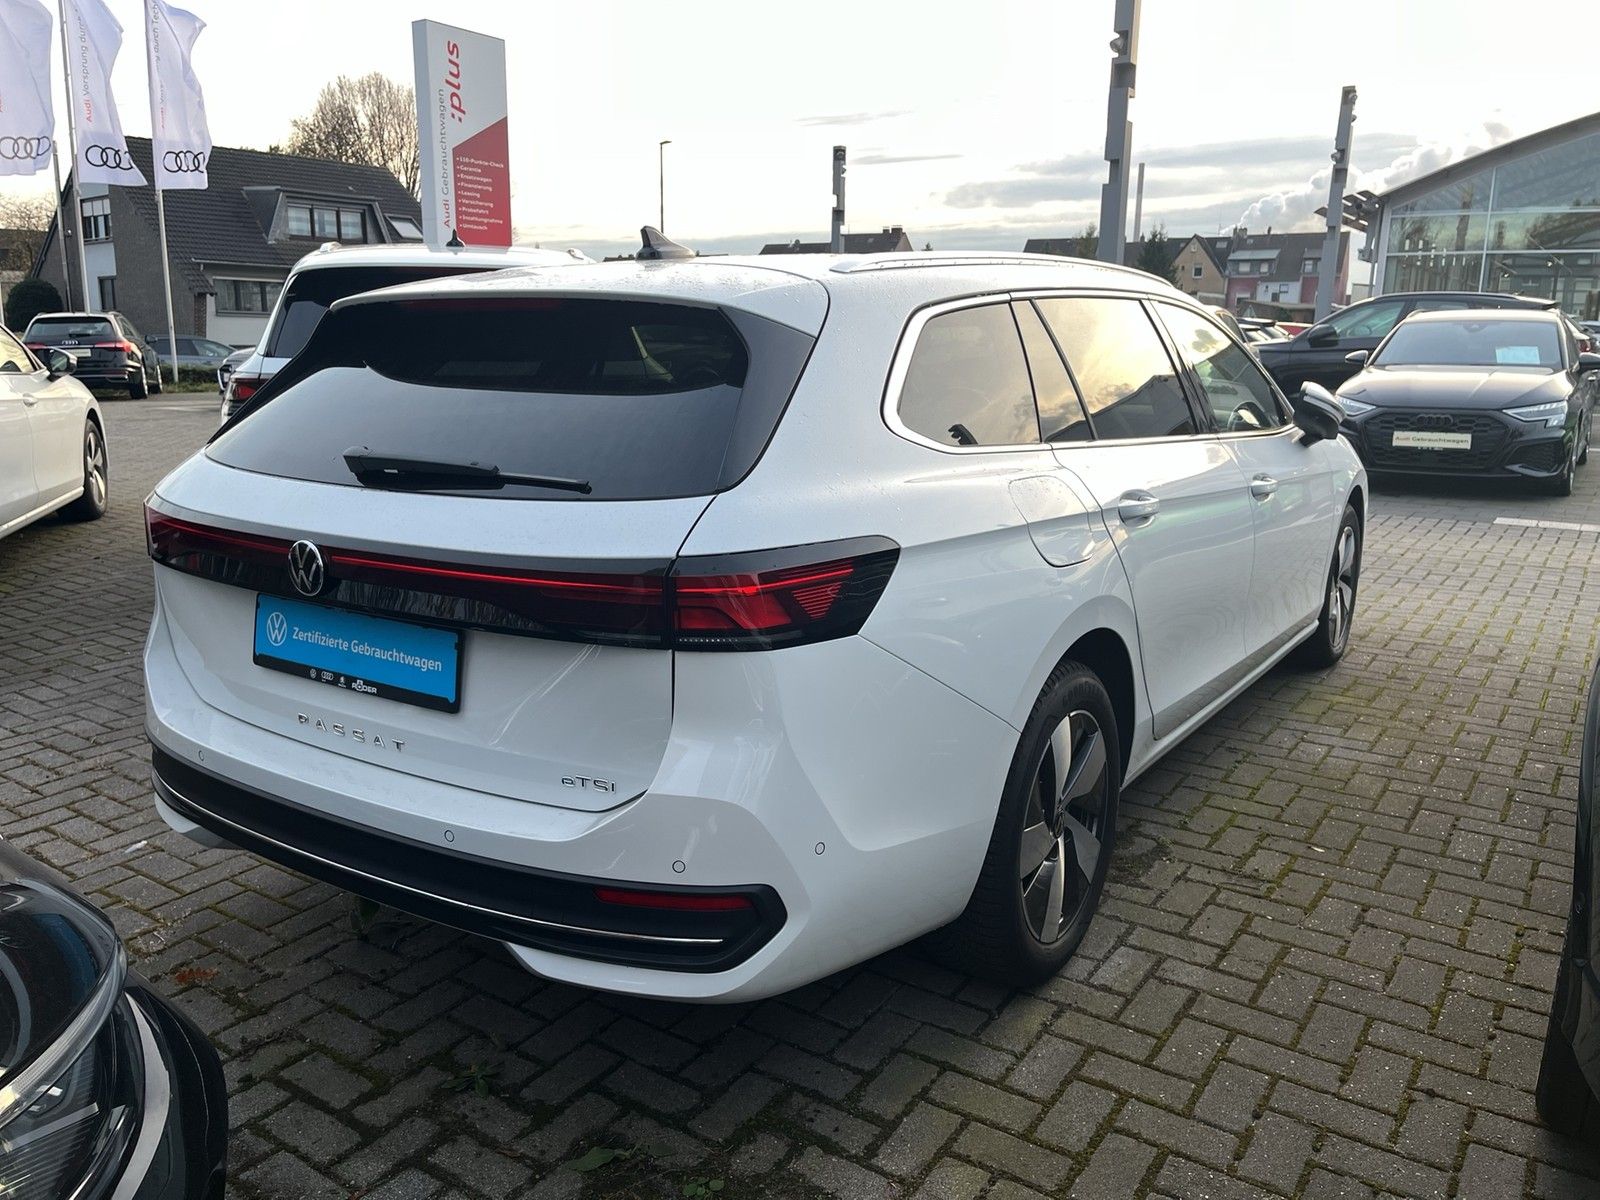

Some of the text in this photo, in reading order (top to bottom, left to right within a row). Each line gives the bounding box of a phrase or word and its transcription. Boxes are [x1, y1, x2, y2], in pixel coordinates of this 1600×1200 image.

[80, 45, 90, 96] Vorsprung
[84, 98, 93, 123] Audi
[438, 88, 451, 229] Audi Gebrauchtwagen
[1412, 436, 1470, 444] Gebrauchtwagen
[292, 626, 442, 672] Zertifizierte Gebrauchtwagen
[297, 712, 405, 752] PASSAT
[561, 774, 616, 794] eTSI
